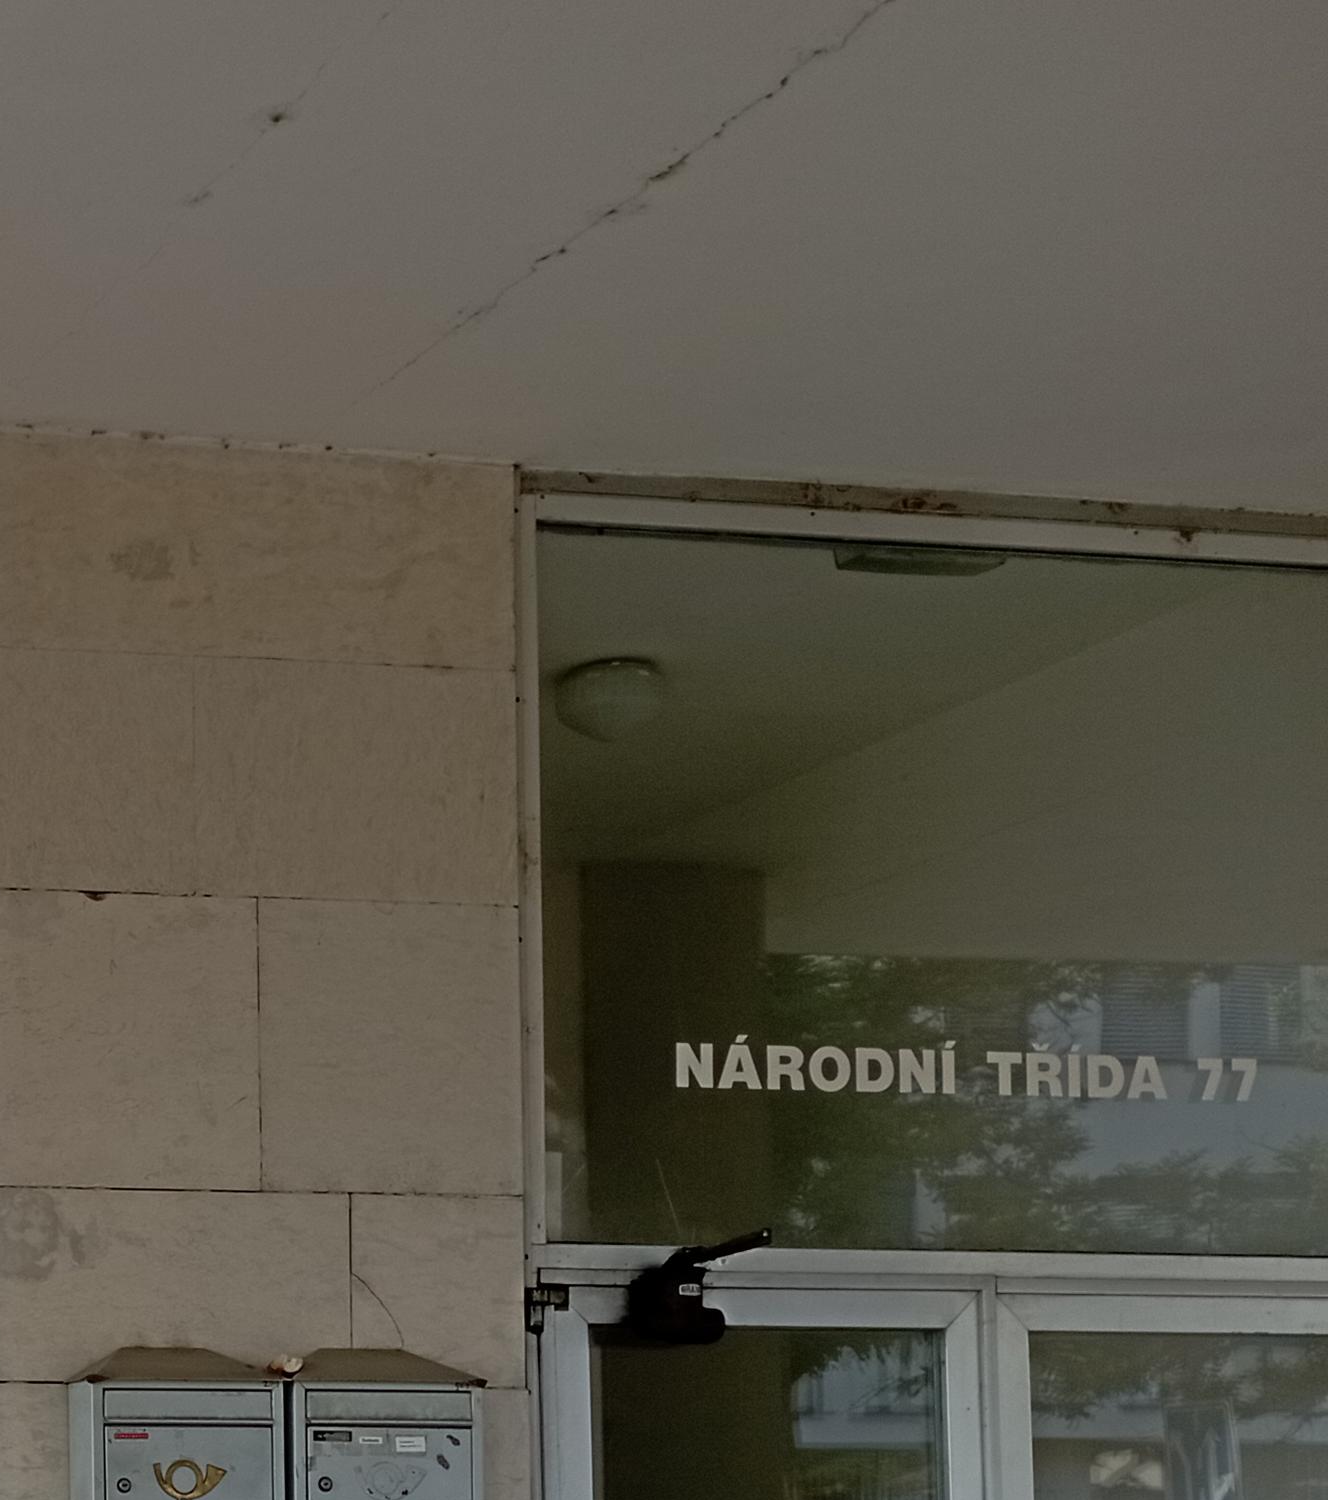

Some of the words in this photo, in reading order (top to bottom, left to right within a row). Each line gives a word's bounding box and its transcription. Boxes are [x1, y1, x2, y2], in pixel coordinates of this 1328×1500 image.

[675, 1034, 956, 1095] NÁRODNÍ
[986, 1043, 1167, 1100] TŘÍDA
[1196, 1057, 1258, 1102] 77
